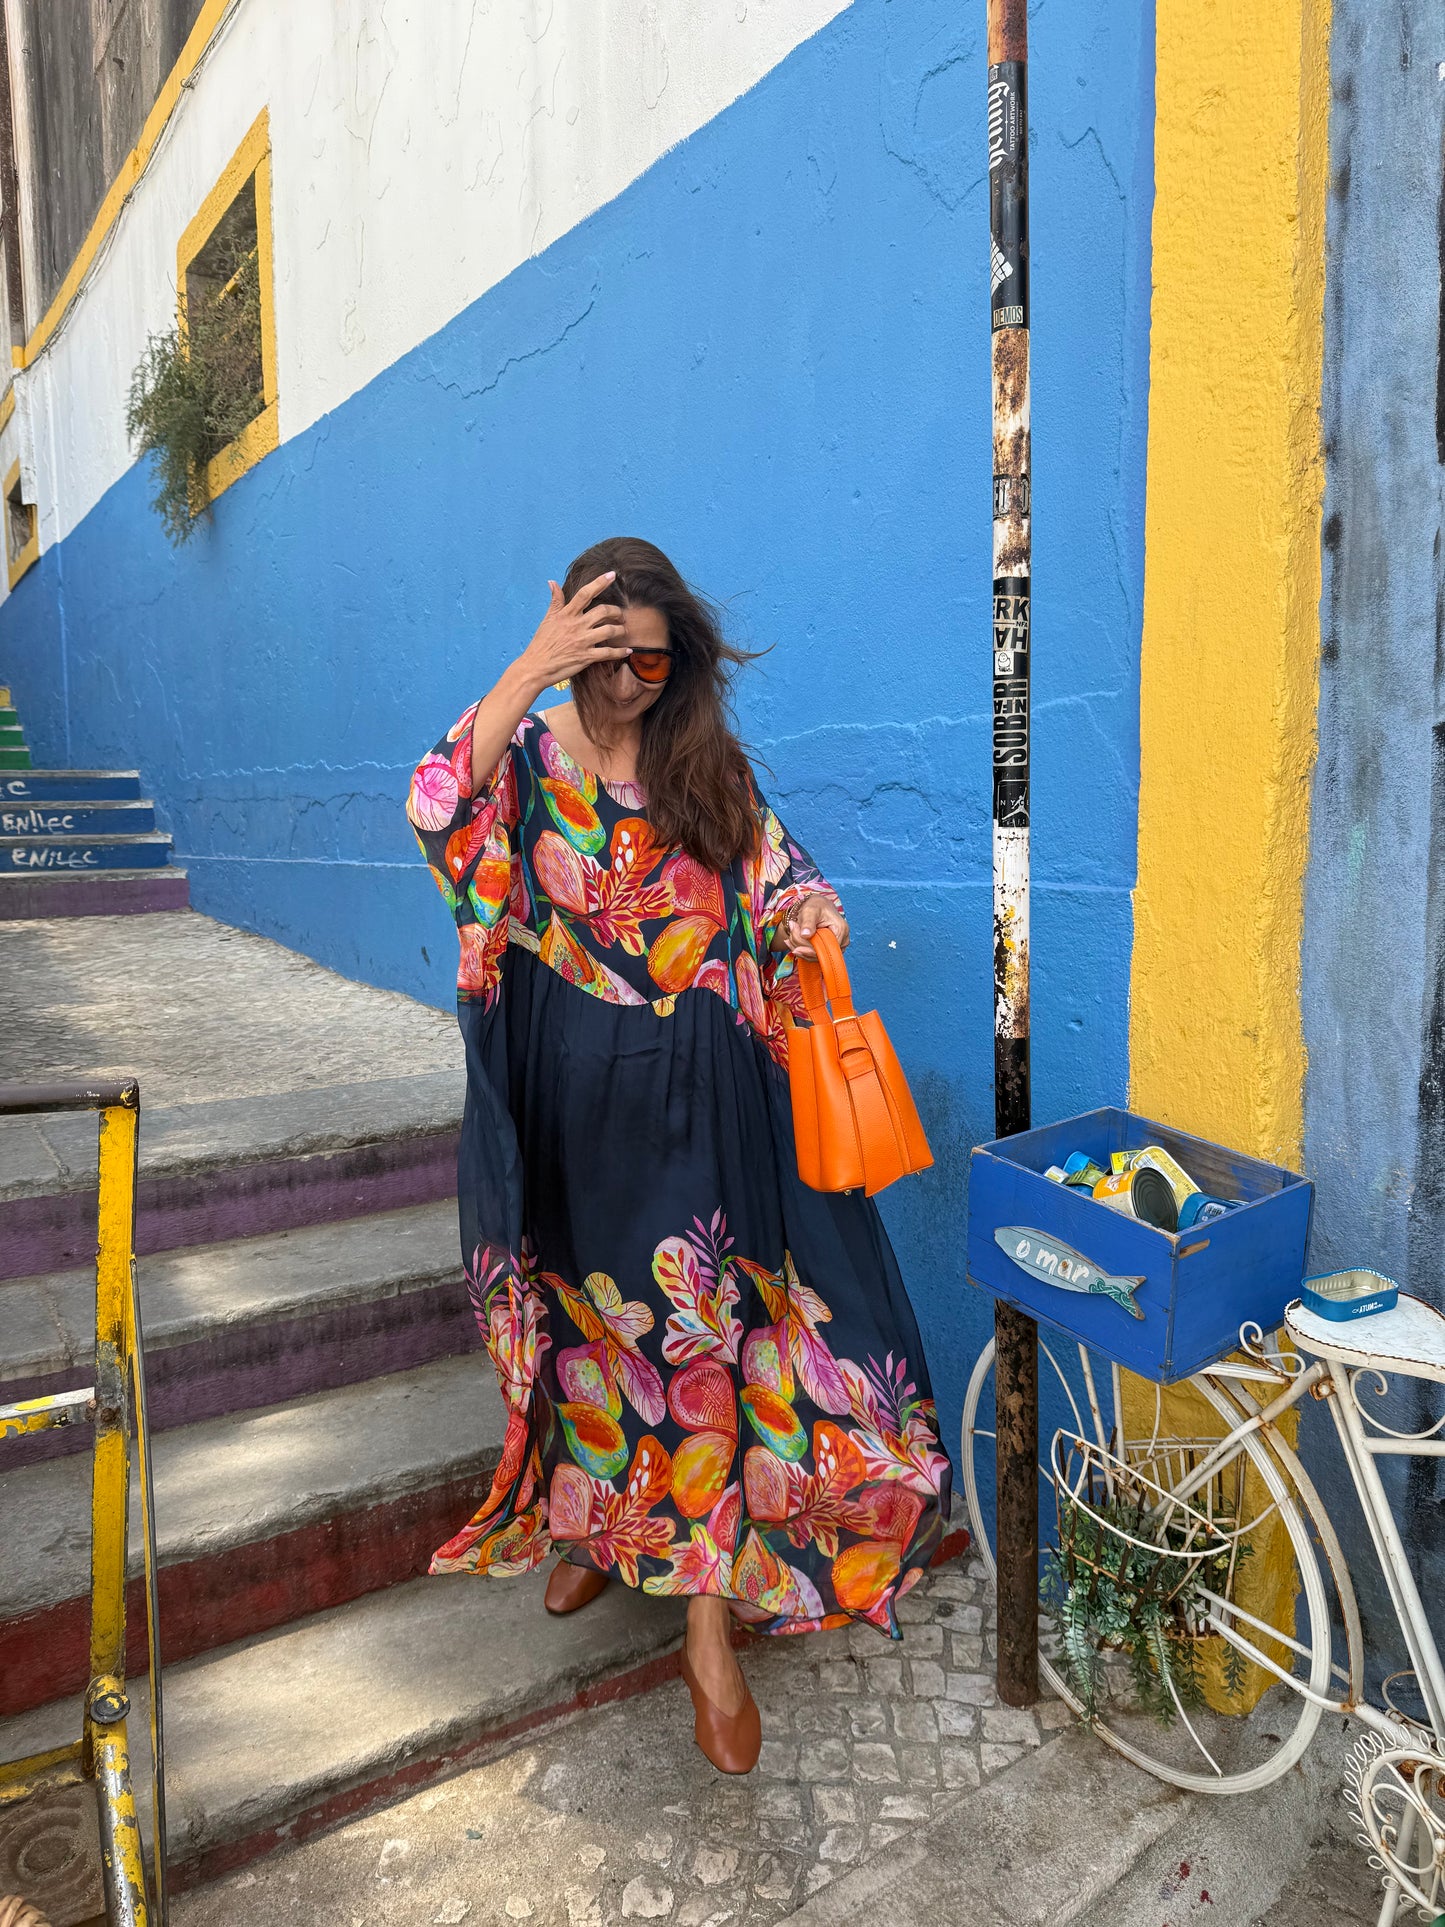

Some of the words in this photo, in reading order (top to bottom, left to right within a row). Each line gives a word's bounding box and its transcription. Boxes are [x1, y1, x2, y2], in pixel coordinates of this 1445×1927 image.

[995, 307, 1022, 326] DEMOS
[993, 598, 1029, 620] RK
[1035, 1248, 1090, 1283] mar
